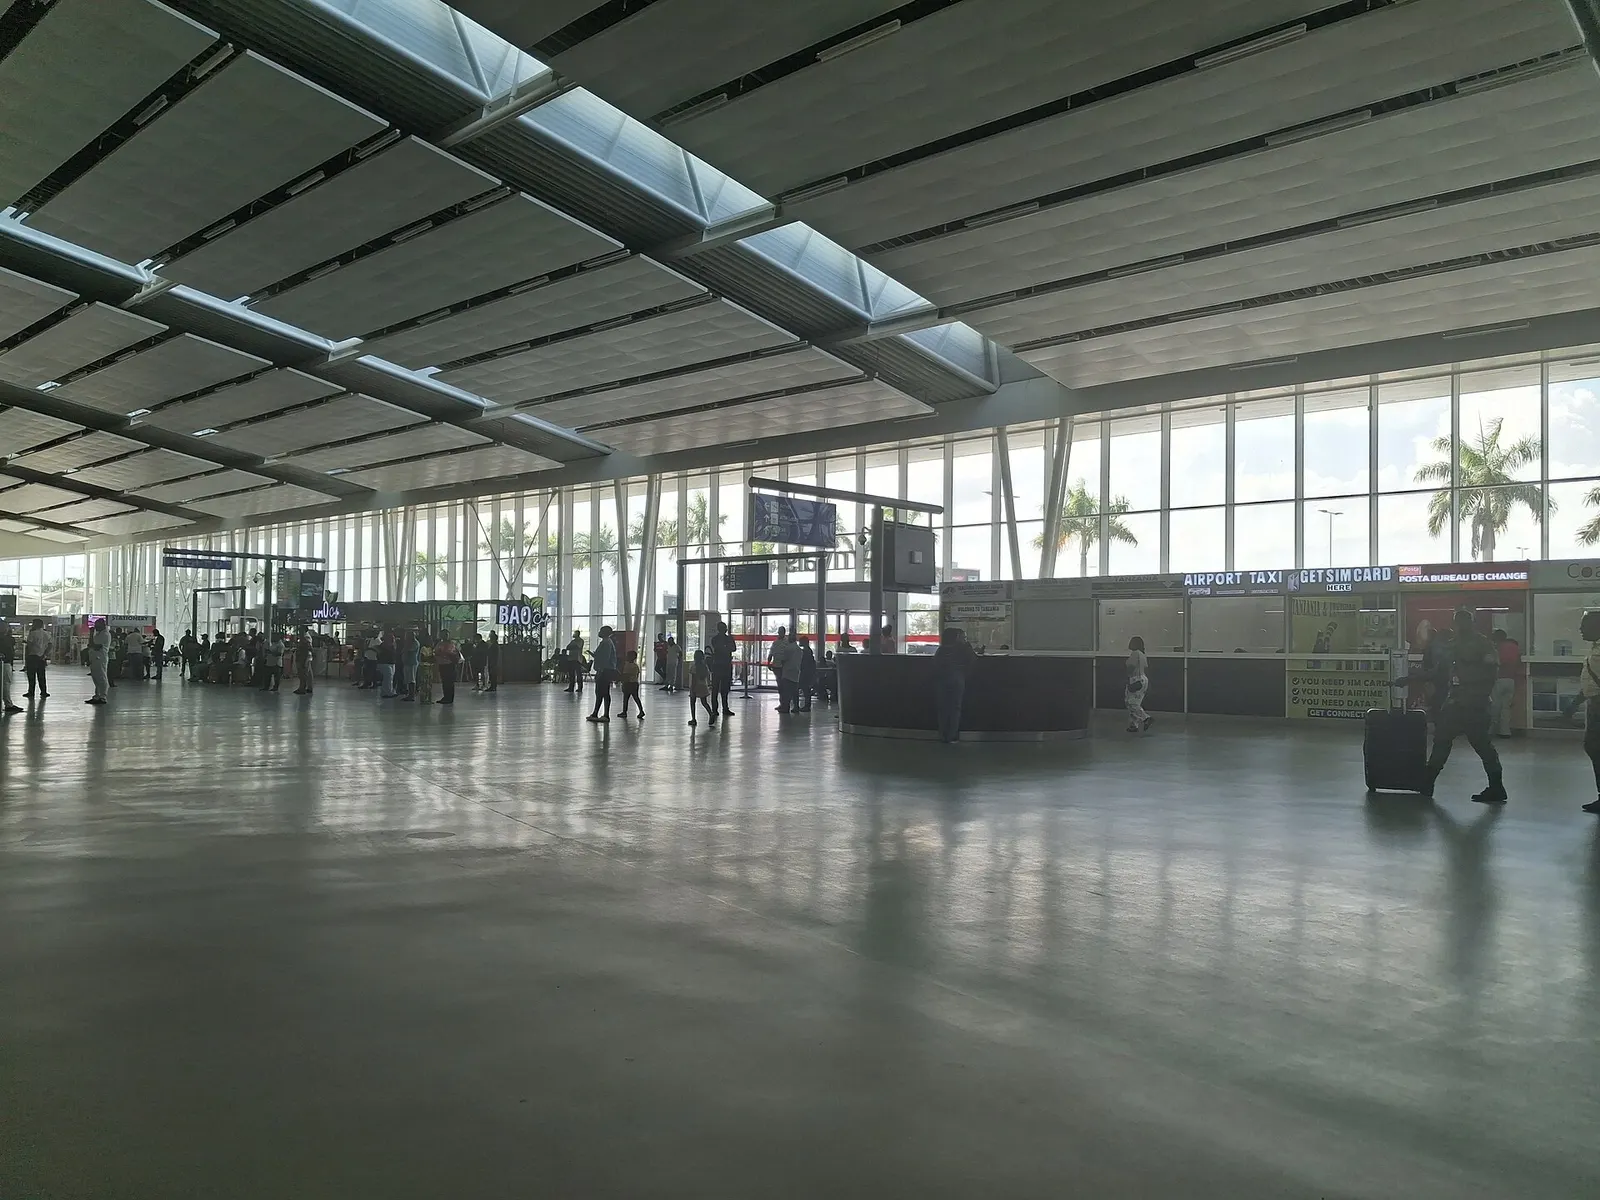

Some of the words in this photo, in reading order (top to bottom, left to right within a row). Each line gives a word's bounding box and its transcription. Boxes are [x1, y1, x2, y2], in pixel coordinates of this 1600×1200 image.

[1184, 572, 1243, 586] AIRPORT
[1249, 570, 1283, 584] TAXI
[1300, 570, 1324, 583] GET
[1326, 568, 1352, 582] SIM
[1353, 567, 1391, 582] CARD
[1399, 575, 1430, 583] POSTA
[1430, 574, 1470, 582] BUREAU
[1471, 573, 1485, 581] DE
[1485, 572, 1528, 581] CHANGE
[1326, 583, 1351, 591] HERE
[499, 606, 531, 624] BAO
[1301, 677, 1319, 685] YOU
[1322, 678, 1344, 686] NEED
[1363, 679, 1387, 687] CARD
[1301, 688, 1319, 696] YOU
[1322, 688, 1344, 696] NEED
[1347, 689, 1383, 697] AIRTIME
[1301, 698, 1319, 706] YOU
[1321, 699, 1344, 707] NEED
